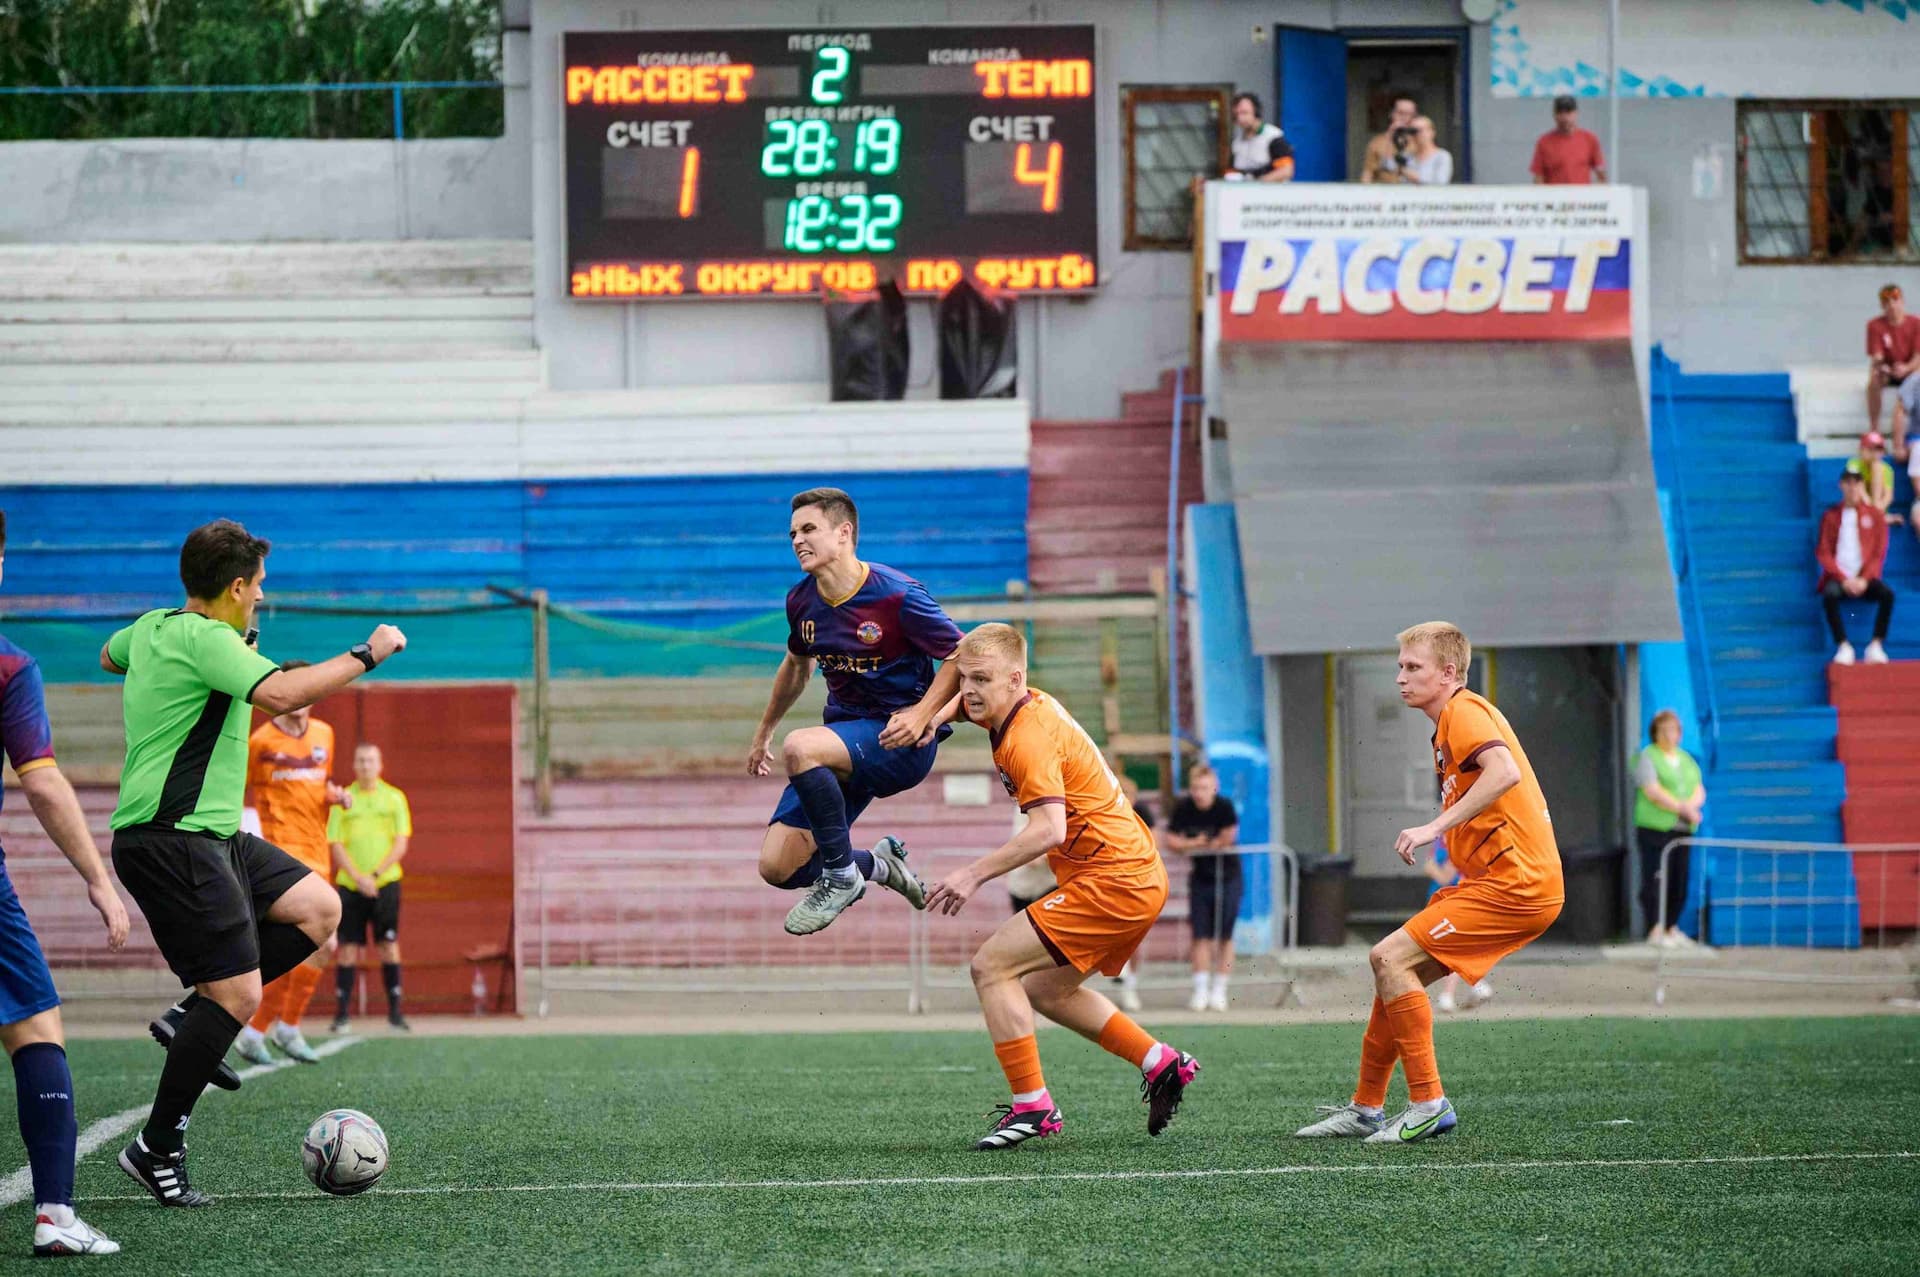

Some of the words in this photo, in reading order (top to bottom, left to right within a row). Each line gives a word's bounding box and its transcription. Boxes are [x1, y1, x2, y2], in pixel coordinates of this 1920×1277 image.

[788, 33, 872, 51] ПЕРИОД
[928, 48, 1022, 64] КОМАНДА
[638, 52, 731, 67] КОМАНДА
[567, 65, 753, 104] РАССВЕТ
[811, 47, 850, 103] 2
[975, 60, 1091, 98] ТЕМП
[607, 121, 692, 147] СЧЕТ
[969, 116, 1054, 142] СЧЕТ
[679, 147, 699, 218] 1
[1014, 142, 1063, 213] 4
[697, 262, 877, 294] ОКРУГОВ
[907, 259, 963, 290] ПО
[1230, 237, 1621, 315] РАССВЕТ
[801, 620, 815, 643] 10
[1428, 918, 1456, 939] 17
